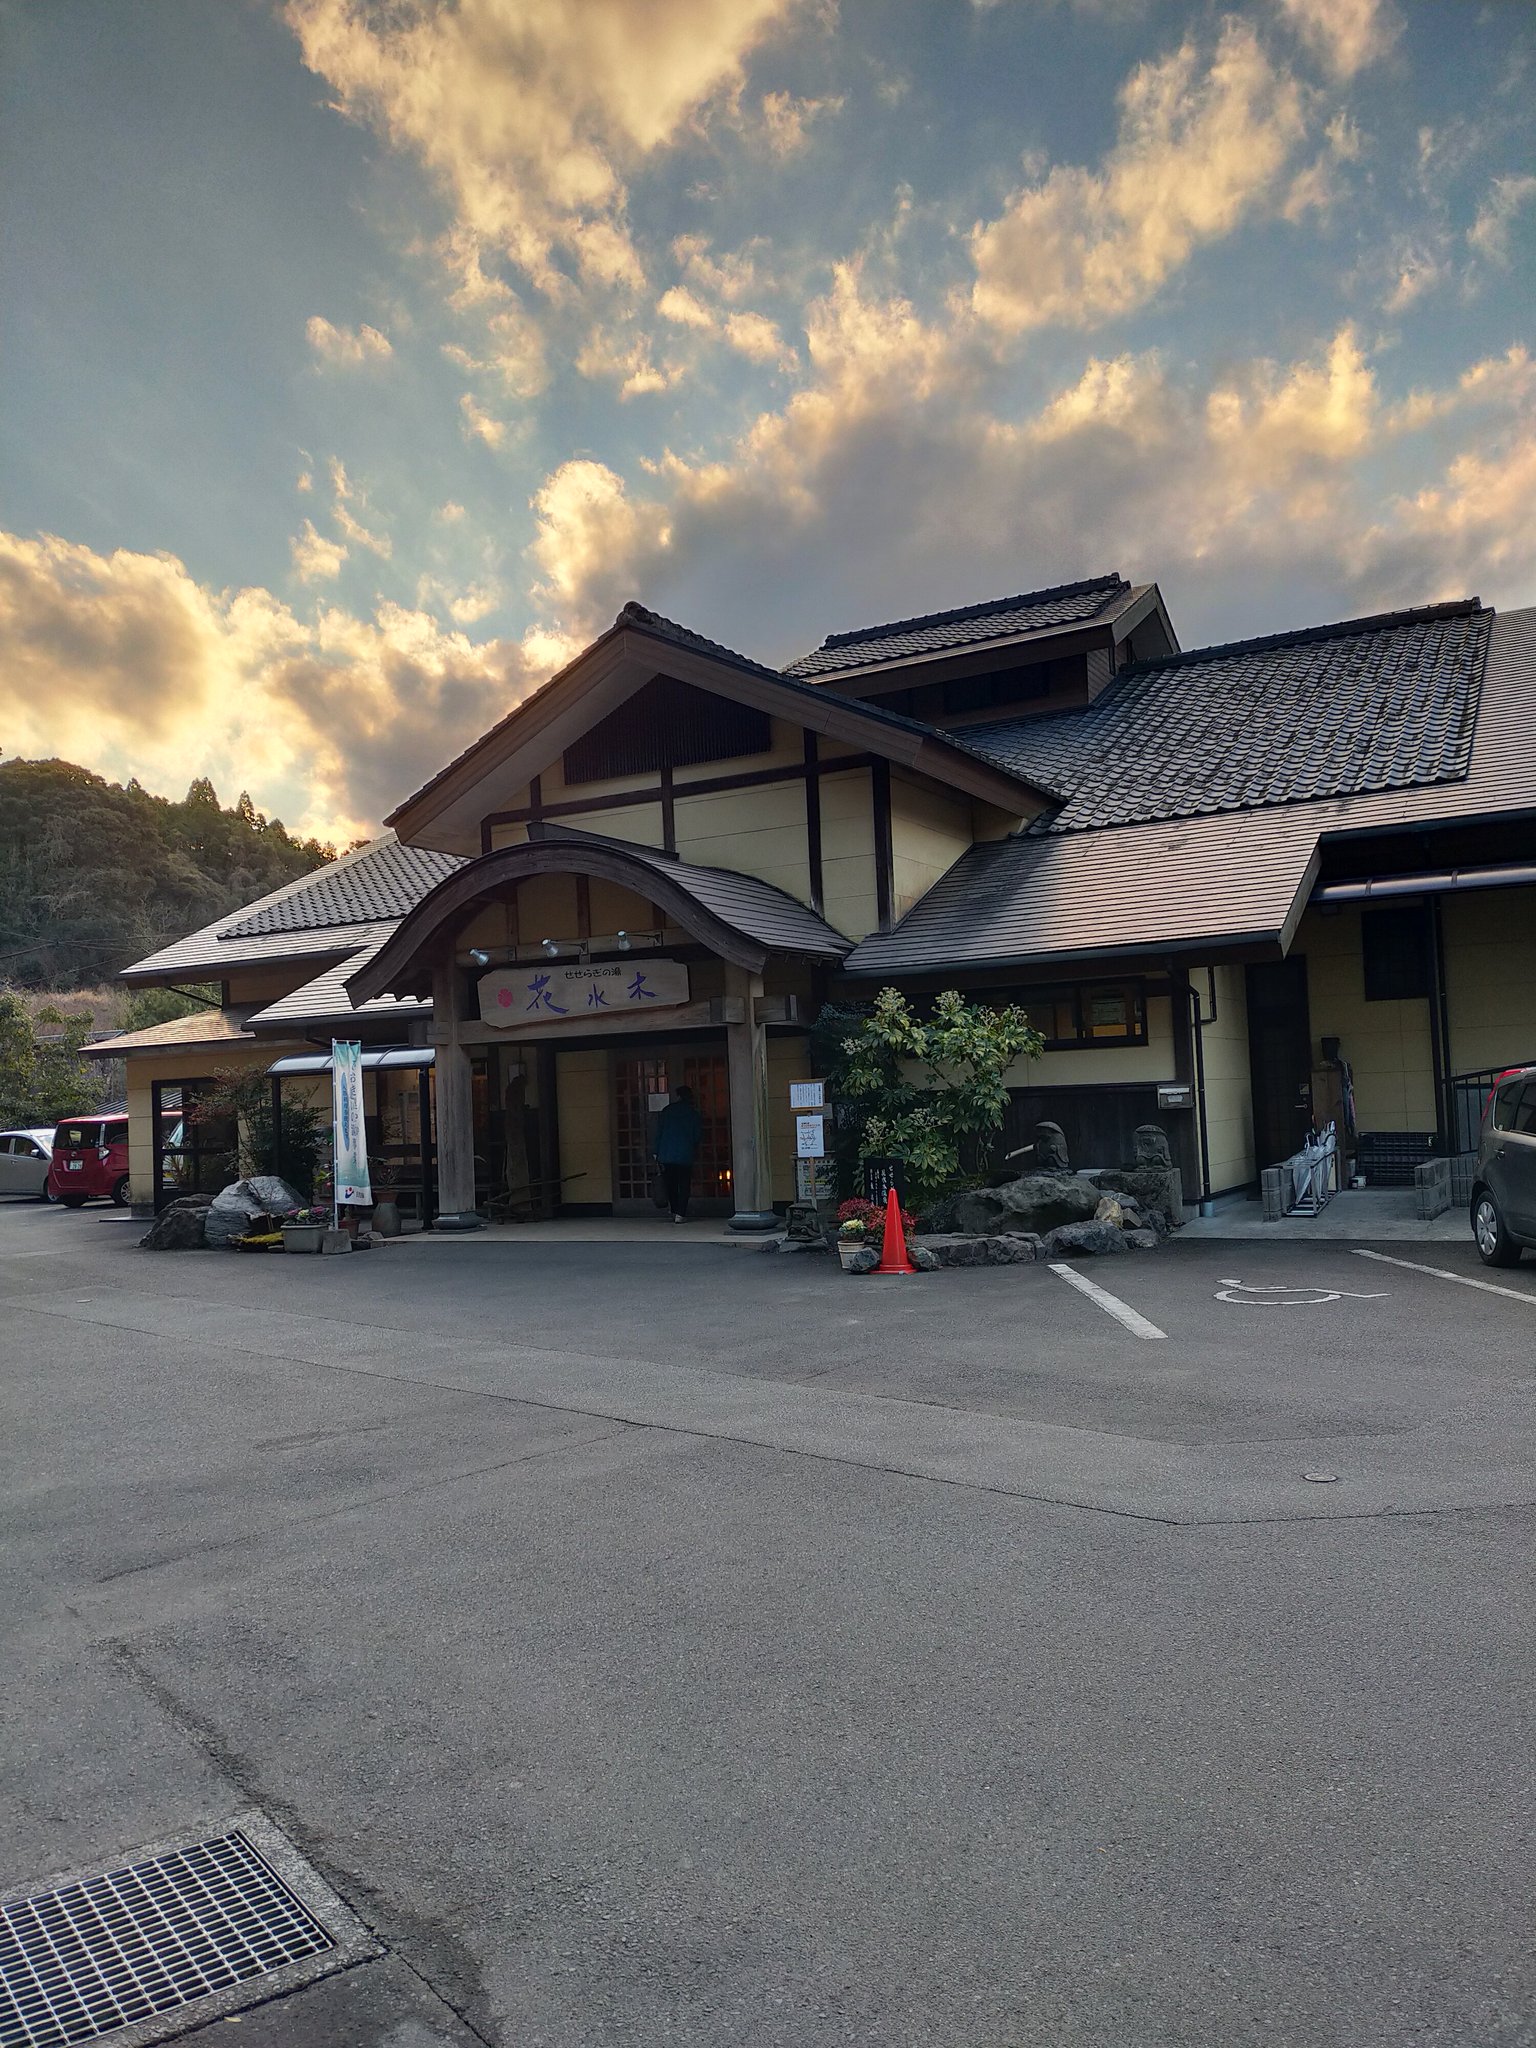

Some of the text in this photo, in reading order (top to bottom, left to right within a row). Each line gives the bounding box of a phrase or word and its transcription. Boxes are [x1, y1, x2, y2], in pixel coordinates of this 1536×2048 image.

[564, 967, 622, 980] せせらぎの湯
[526, 971, 659, 1014] 花水木
